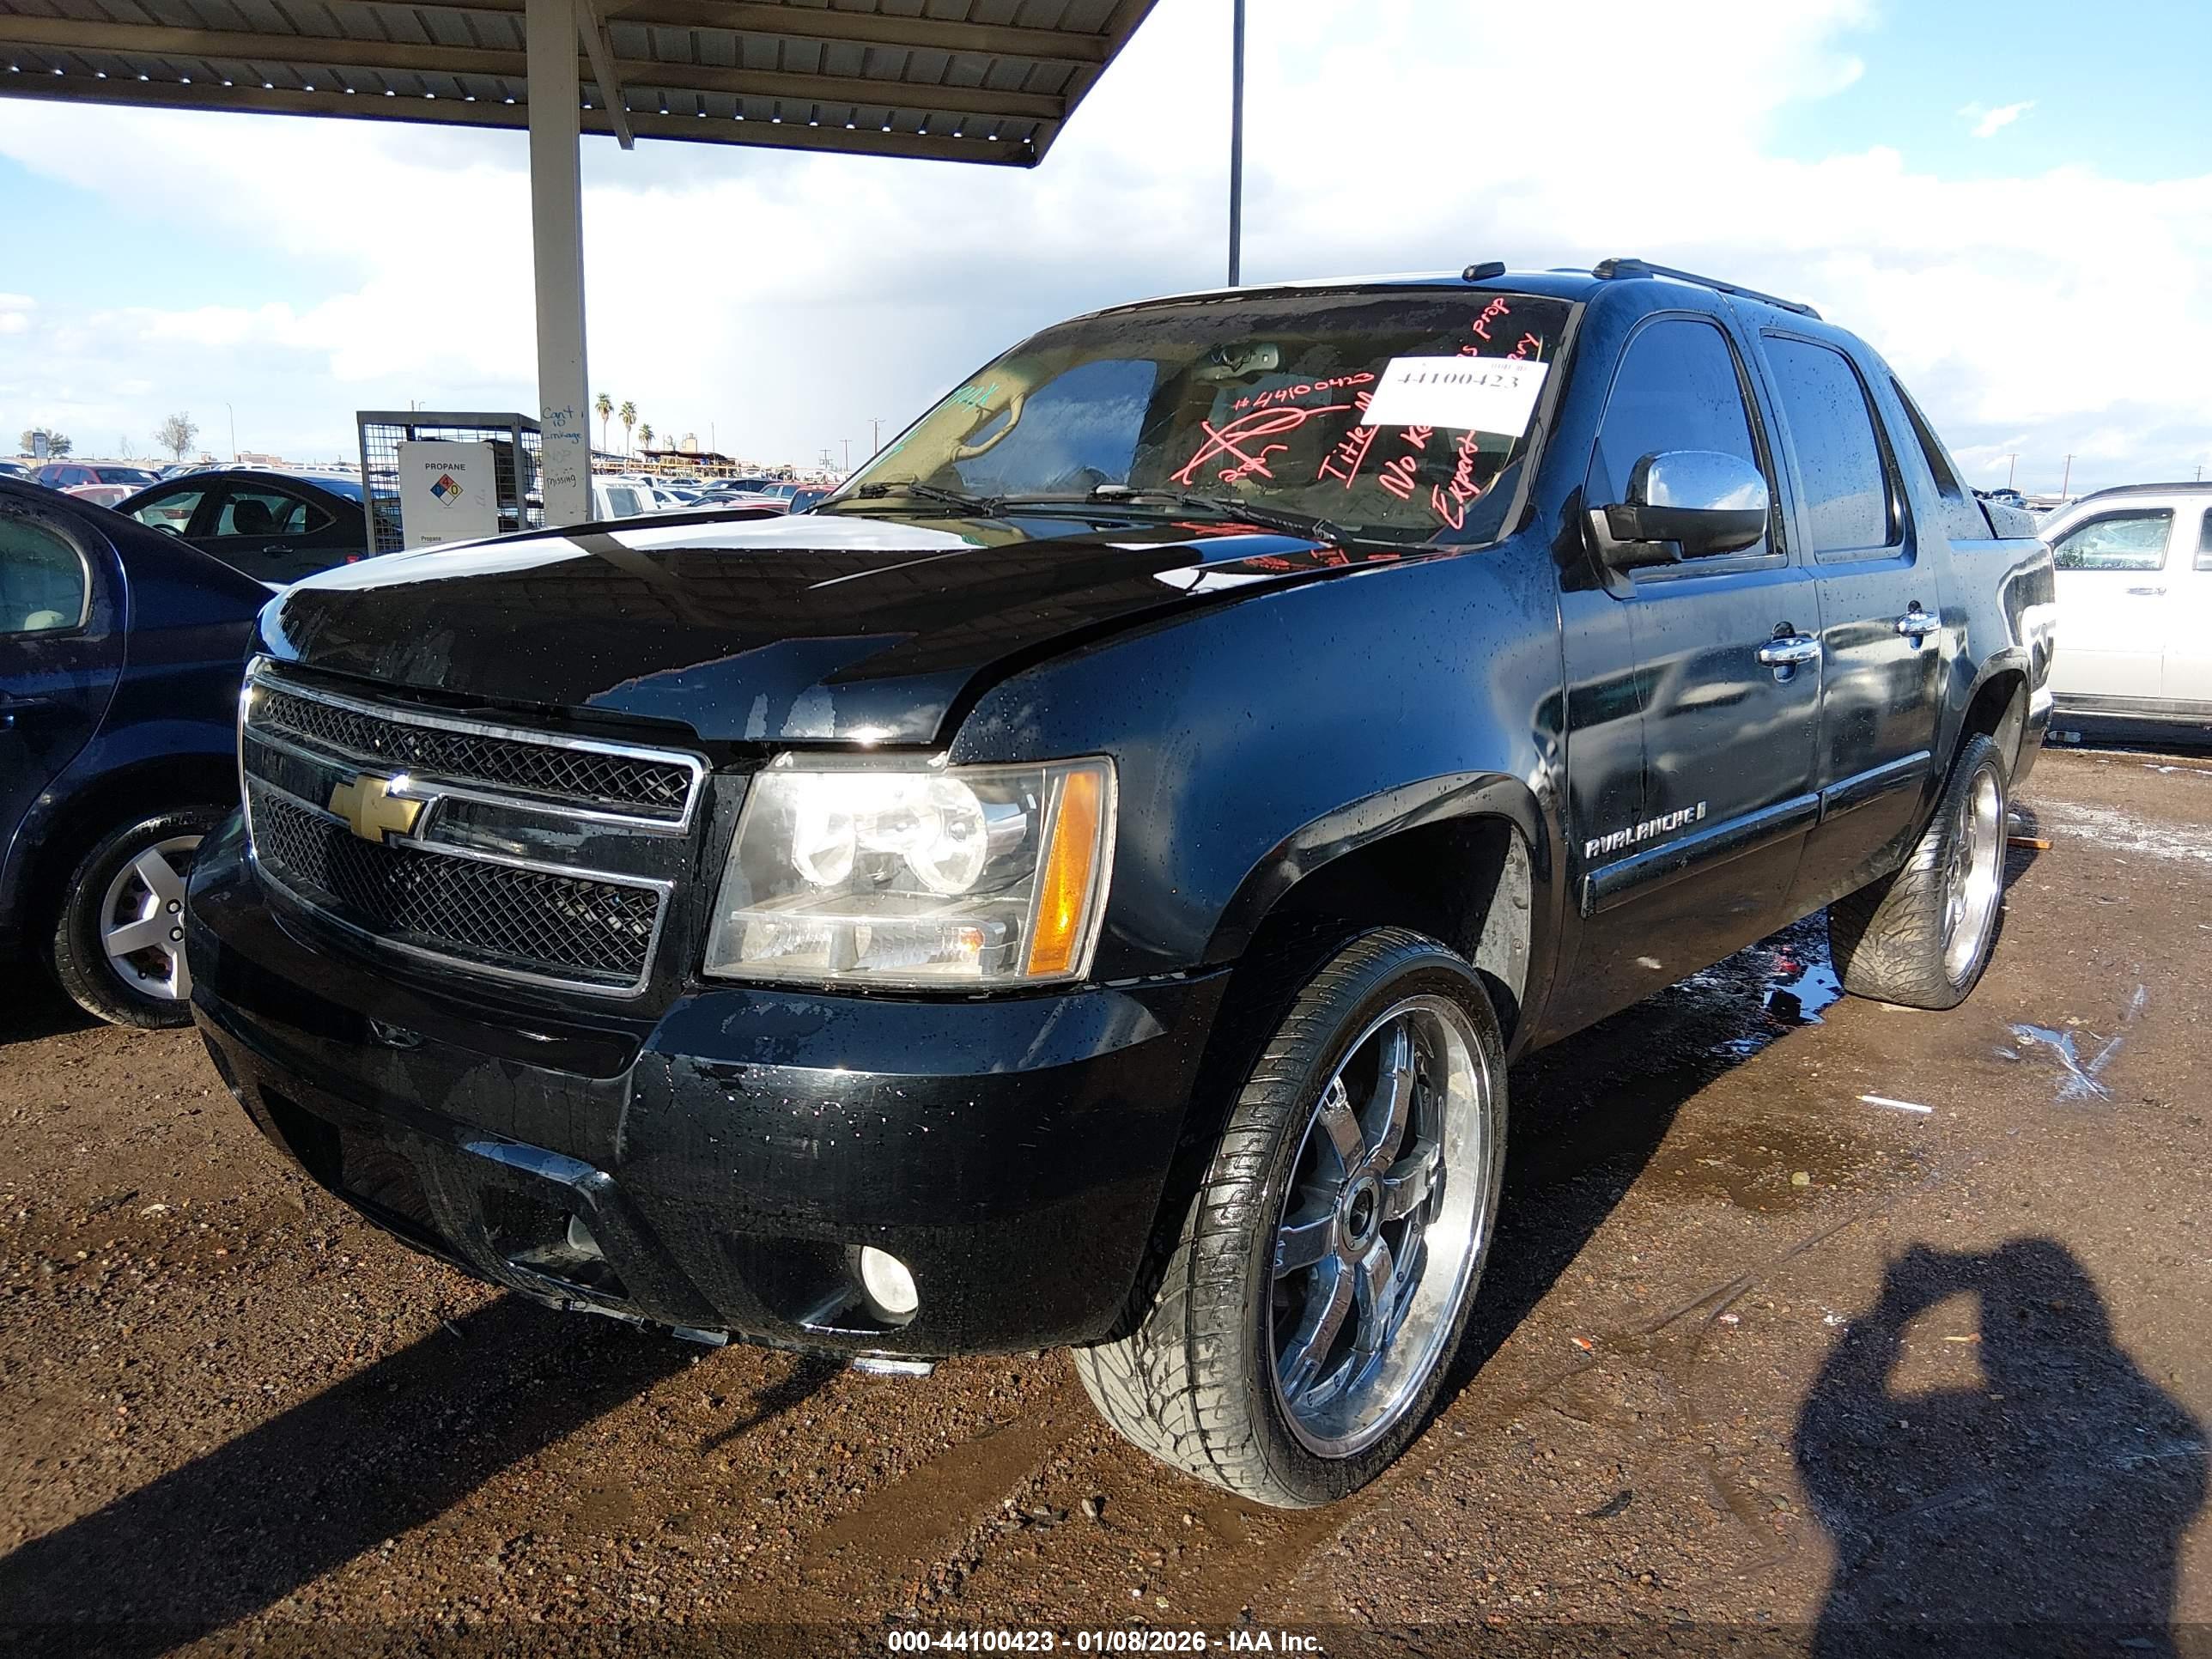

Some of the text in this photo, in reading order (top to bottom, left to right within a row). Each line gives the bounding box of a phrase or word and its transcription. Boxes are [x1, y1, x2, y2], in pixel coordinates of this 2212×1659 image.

[1397, 373, 1519, 388] 44100423
[1317, 427, 1373, 480] Title
[442, 477, 449, 486] 4
[451, 484, 459, 495] 0
[1379, 456, 1417, 500] No
[1585, 806, 1696, 859] AVALANCHE
